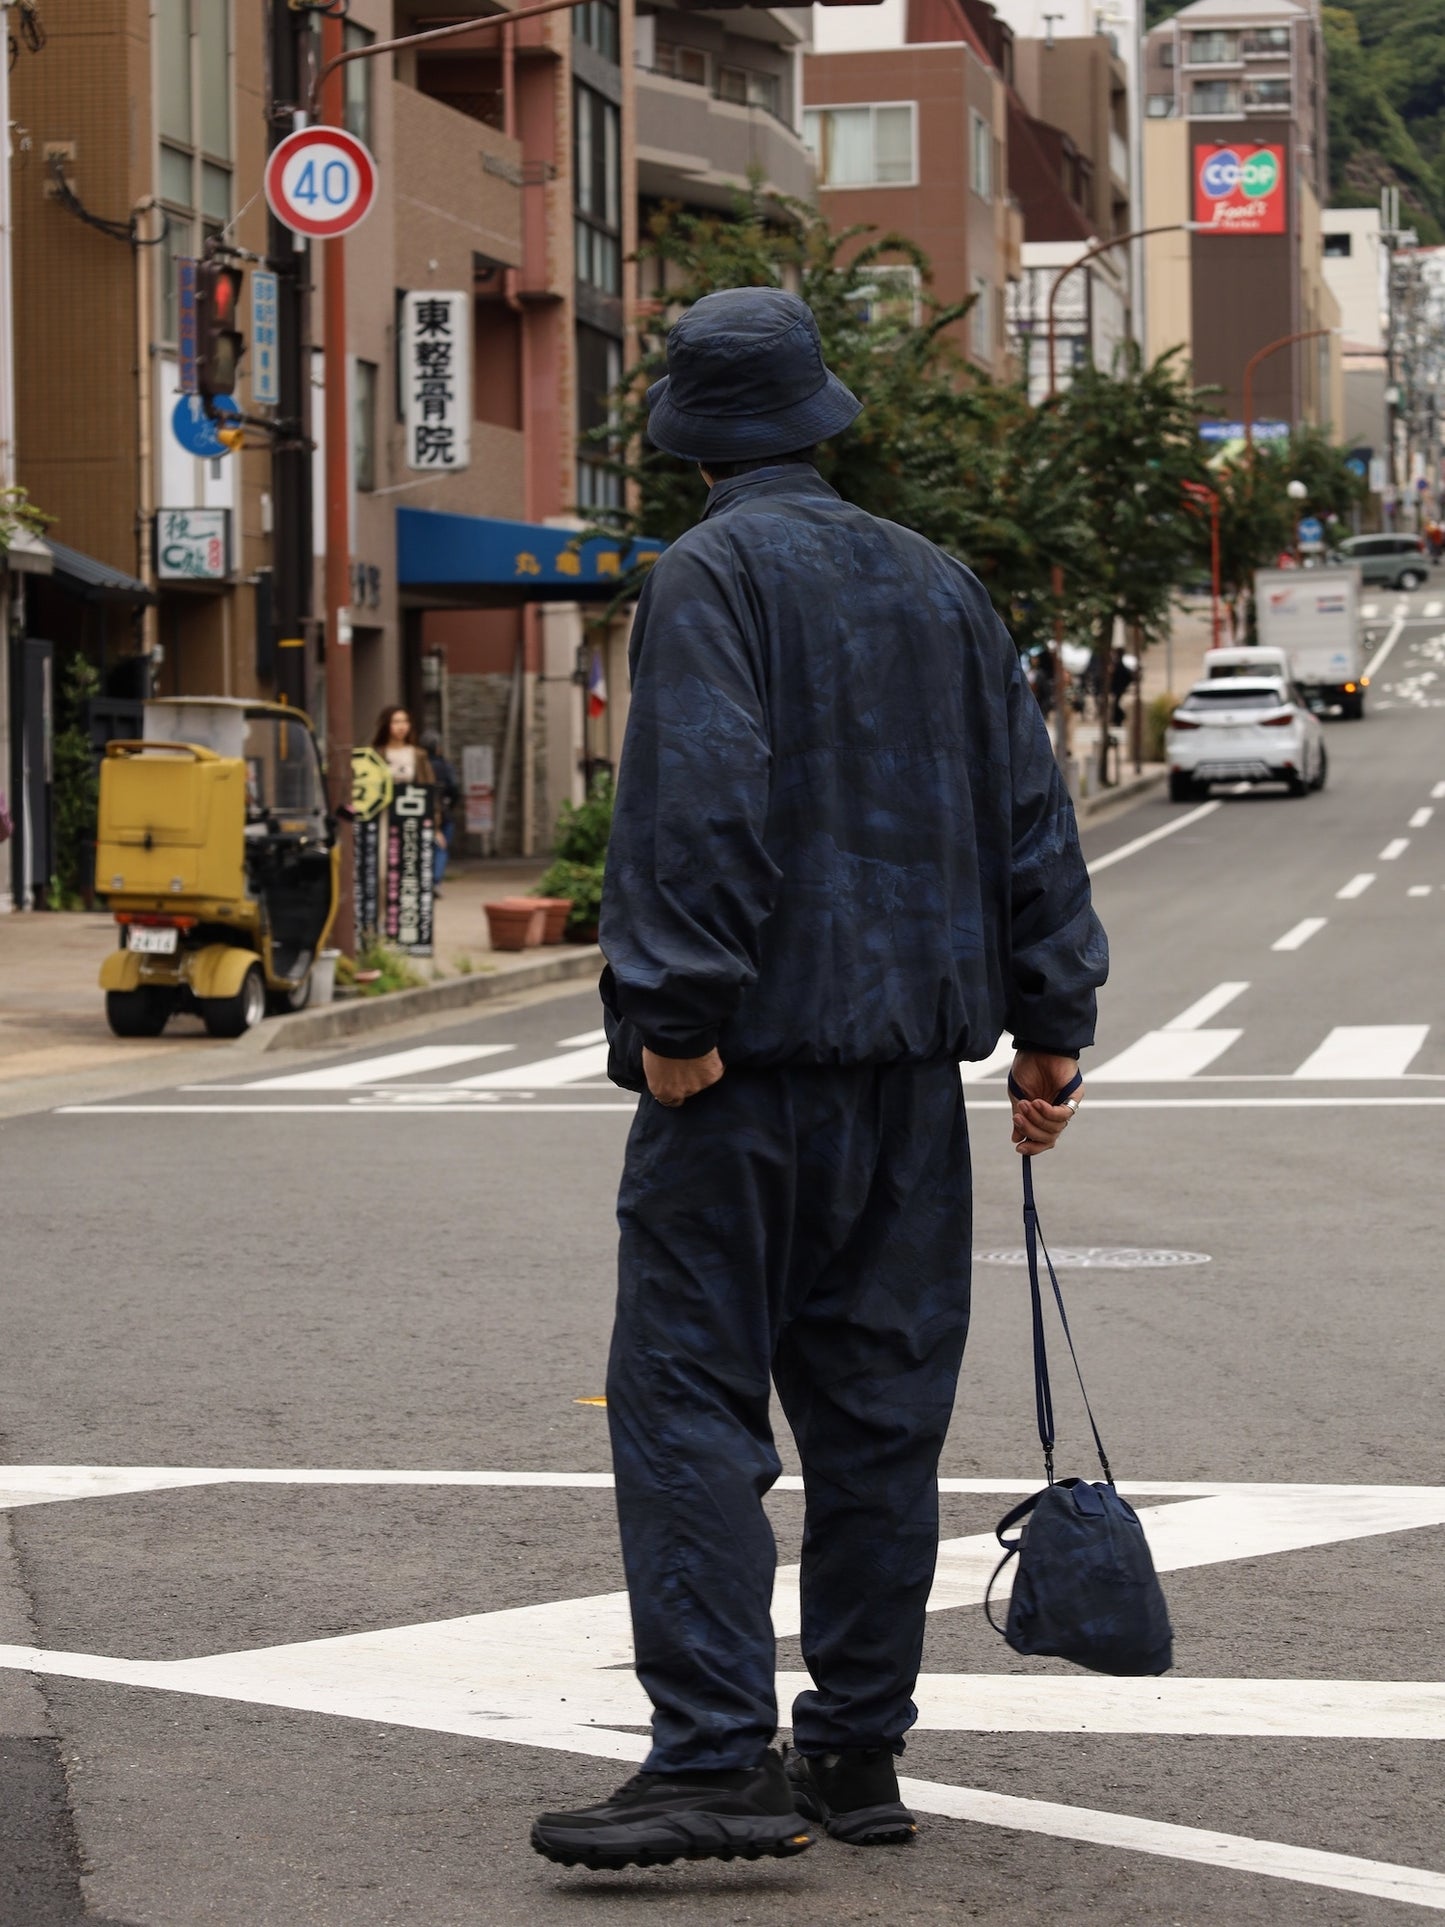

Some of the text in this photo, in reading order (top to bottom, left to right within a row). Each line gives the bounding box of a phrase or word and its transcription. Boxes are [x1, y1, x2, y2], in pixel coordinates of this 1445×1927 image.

[293, 160, 350, 205] 40
[414, 298, 454, 464] 東整骨院
